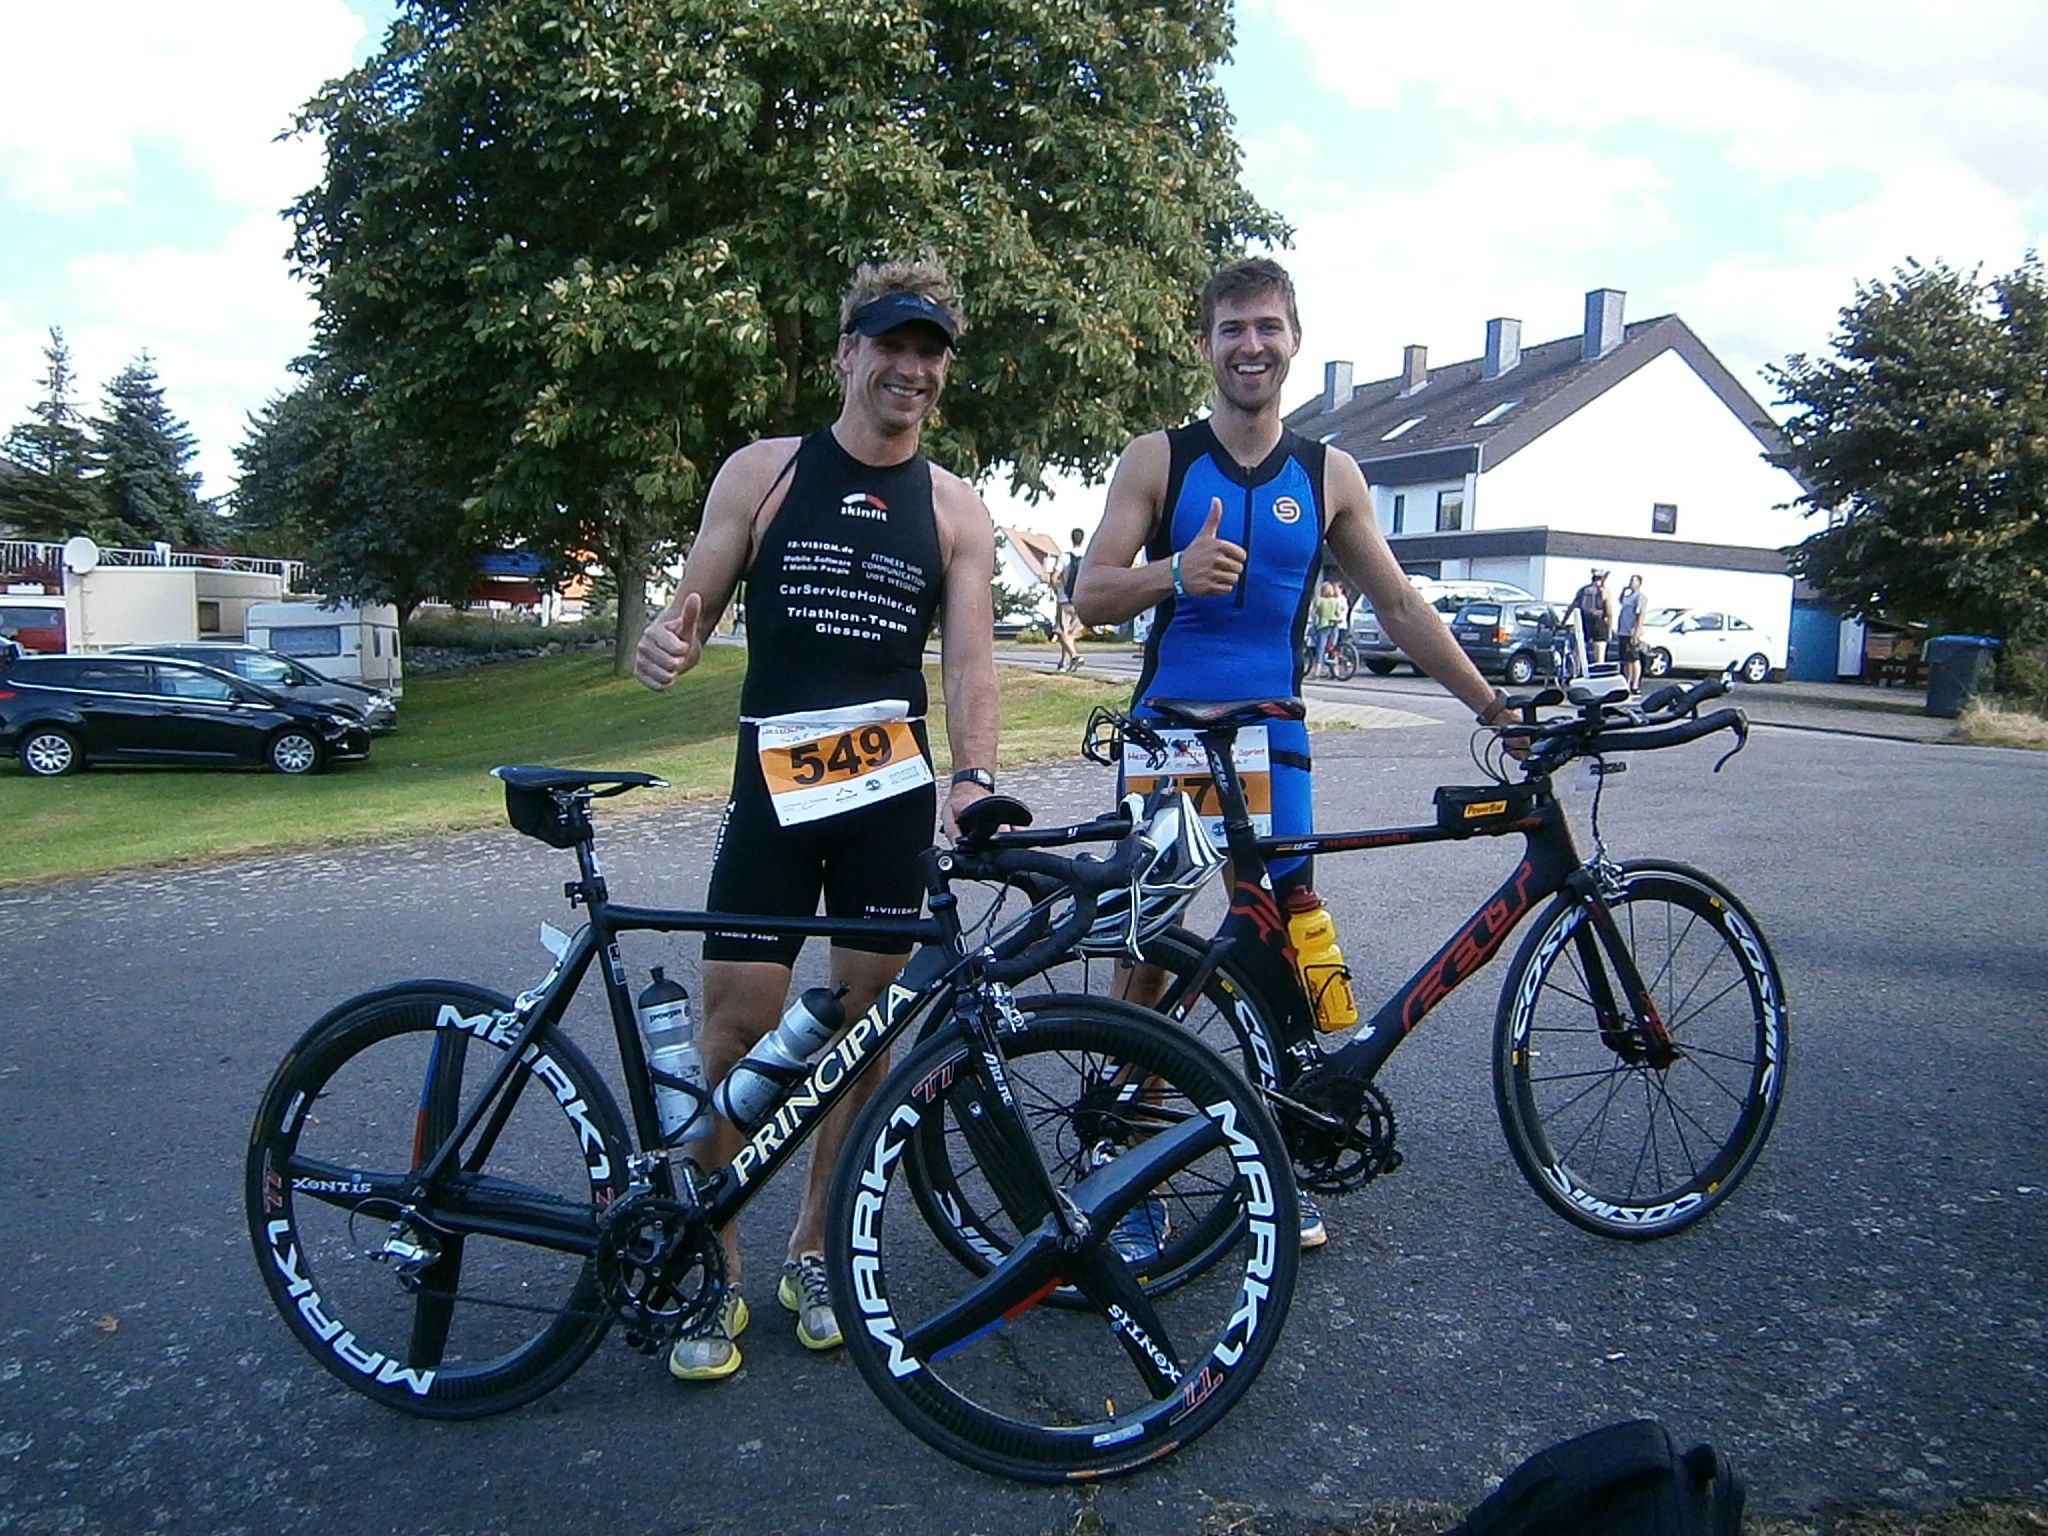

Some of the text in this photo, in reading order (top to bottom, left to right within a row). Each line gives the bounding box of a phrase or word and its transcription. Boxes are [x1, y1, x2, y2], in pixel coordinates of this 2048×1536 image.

[840, 506, 888, 522] skinfit
[787, 607, 908, 633] Triathlon-Team
[815, 623, 882, 641] Giessen
[790, 725, 894, 785] 549
[731, 983, 918, 1188] PRINCIPIA
[852, 1104, 923, 1379] MARK1
[1206, 1100, 1280, 1369] MARK1
[267, 1218, 437, 1396] MARK1
